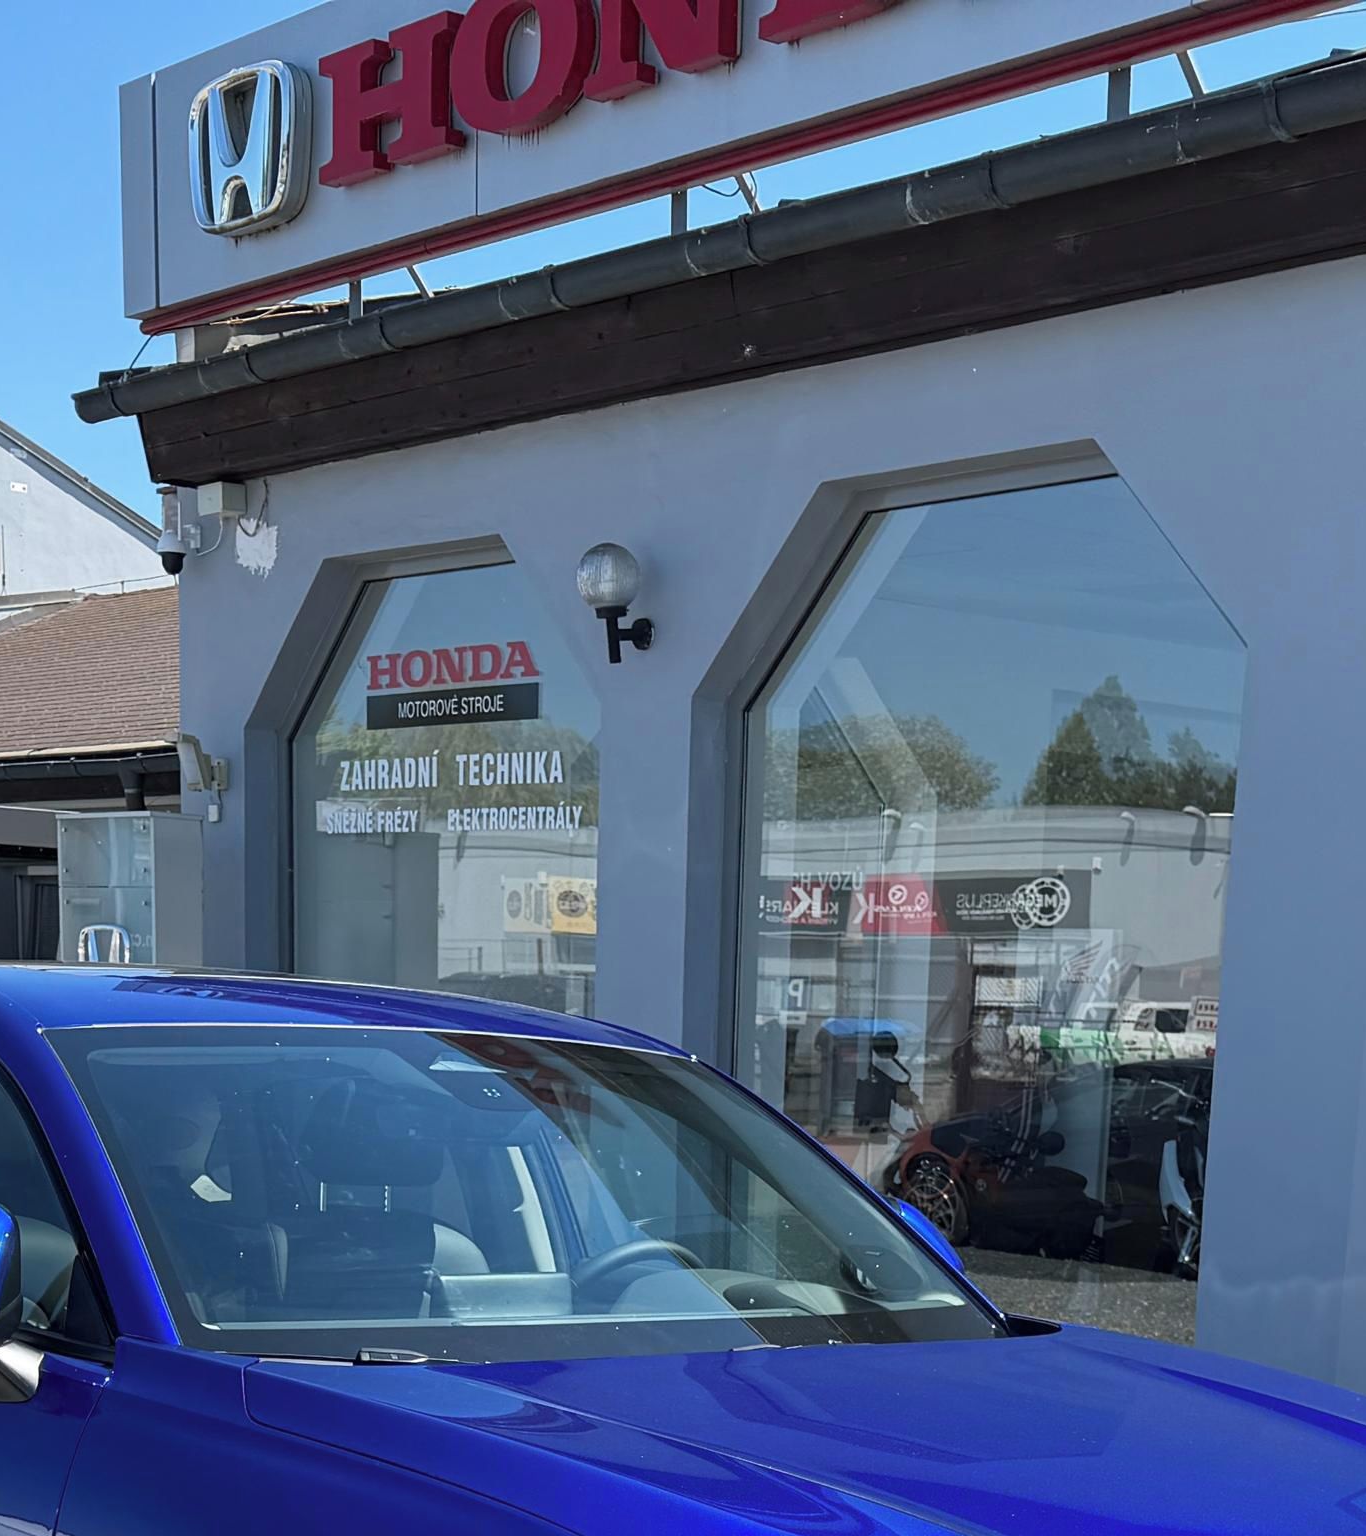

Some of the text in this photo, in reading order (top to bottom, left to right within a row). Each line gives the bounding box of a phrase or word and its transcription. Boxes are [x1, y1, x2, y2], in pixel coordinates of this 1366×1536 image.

[318, 0, 901, 188] HON
[366, 641, 540, 691] HONDA
[397, 694, 504, 719] MOTOROVÉ STROJE
[340, 749, 564, 792] ZAHRADNÍ TECHNIKA
[377, 805, 419, 833] FRÉZY
[447, 801, 583, 832] ELEKTROCENTRÁLY
